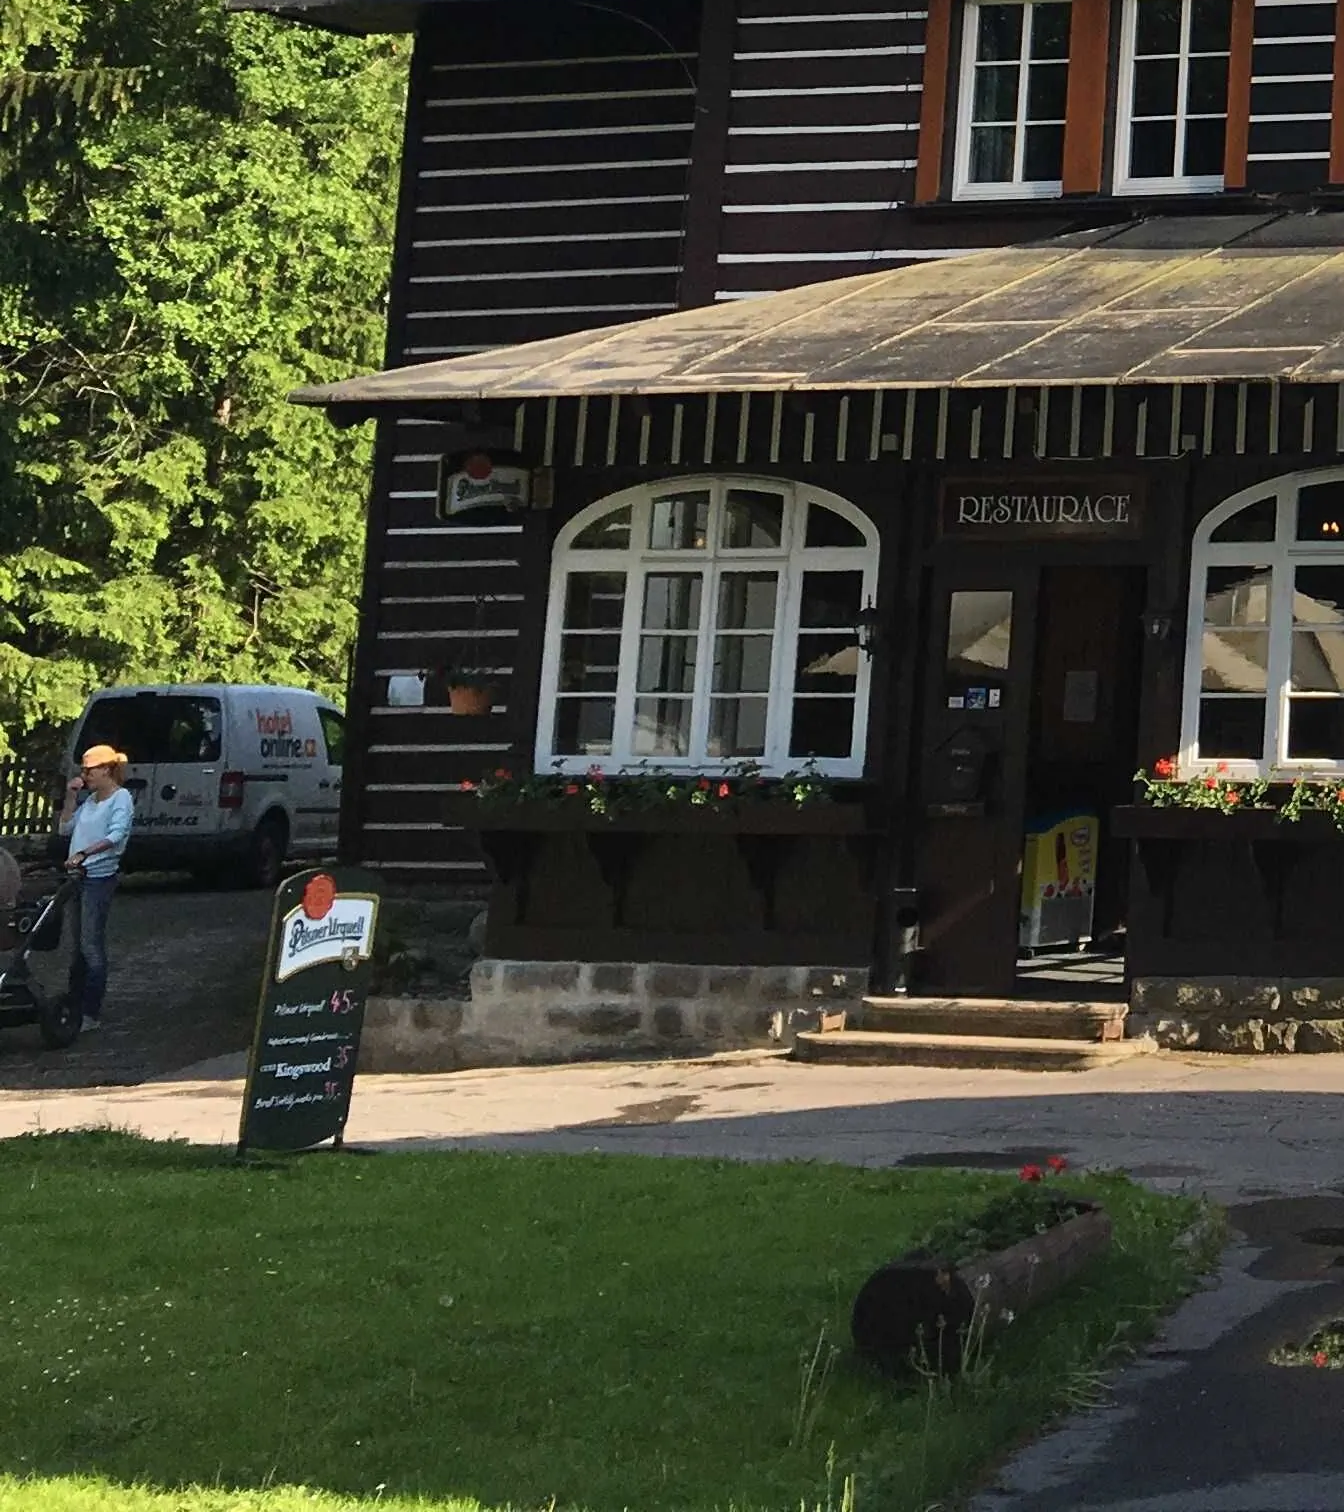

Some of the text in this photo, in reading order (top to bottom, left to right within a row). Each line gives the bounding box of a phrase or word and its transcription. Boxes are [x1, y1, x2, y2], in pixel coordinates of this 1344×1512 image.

[957, 494, 1132, 525] RESTAURACE
[255, 707, 293, 735] hotel
[288, 916, 365, 958] Pilsner Urquell
[275, 1057, 331, 1080] Kingswood
